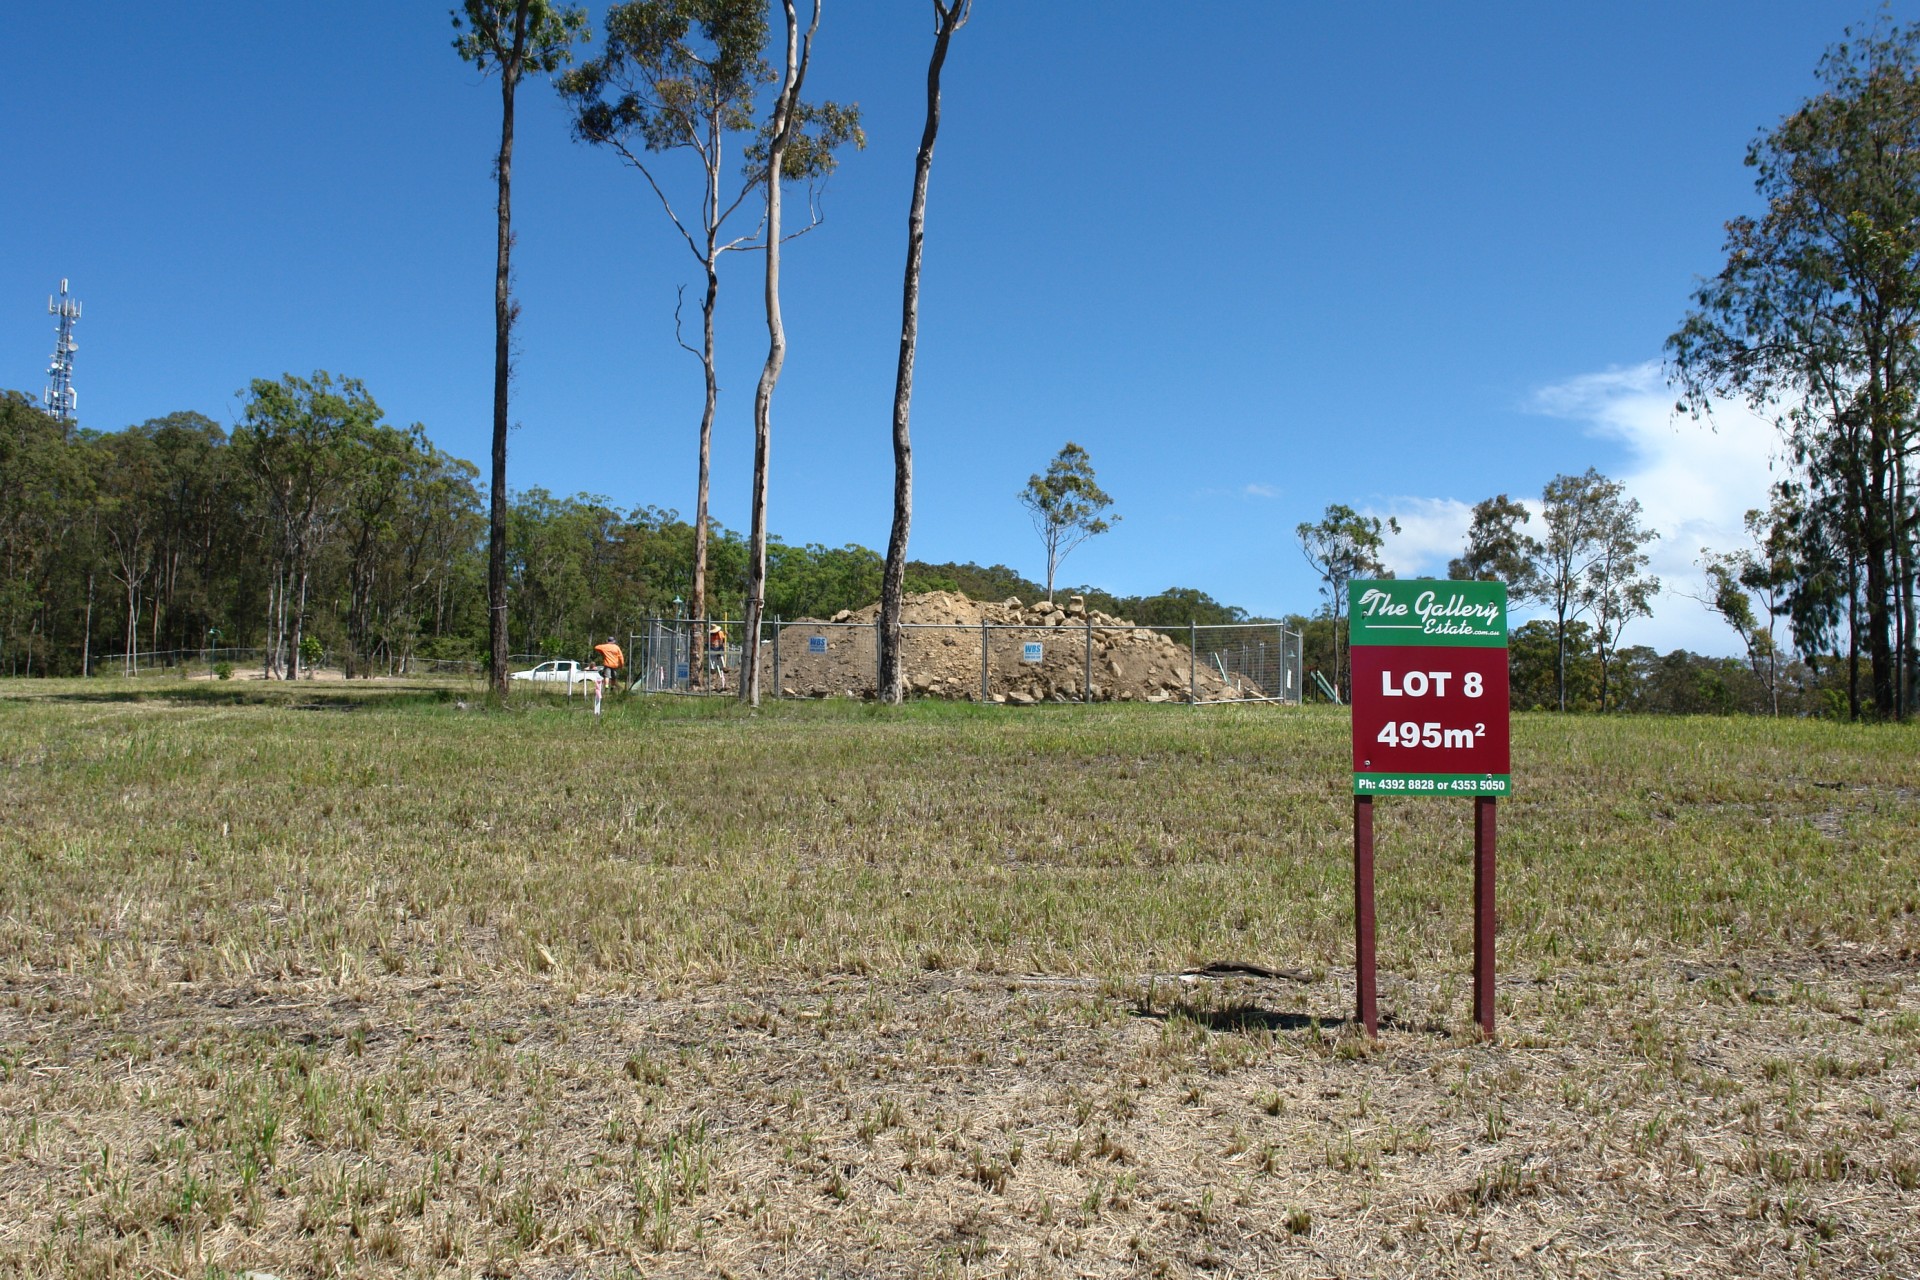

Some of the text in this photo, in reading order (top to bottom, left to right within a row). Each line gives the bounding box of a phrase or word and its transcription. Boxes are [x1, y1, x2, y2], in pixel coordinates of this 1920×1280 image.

[1359, 589, 1499, 626] The Gallery
[1025, 644, 1041, 653] WBS
[1382, 671, 1483, 698] LOT 8
[1377, 721, 1486, 749] 495m²
[1359, 779, 1505, 791] Ph: 4392 8828 or 4353 5050
